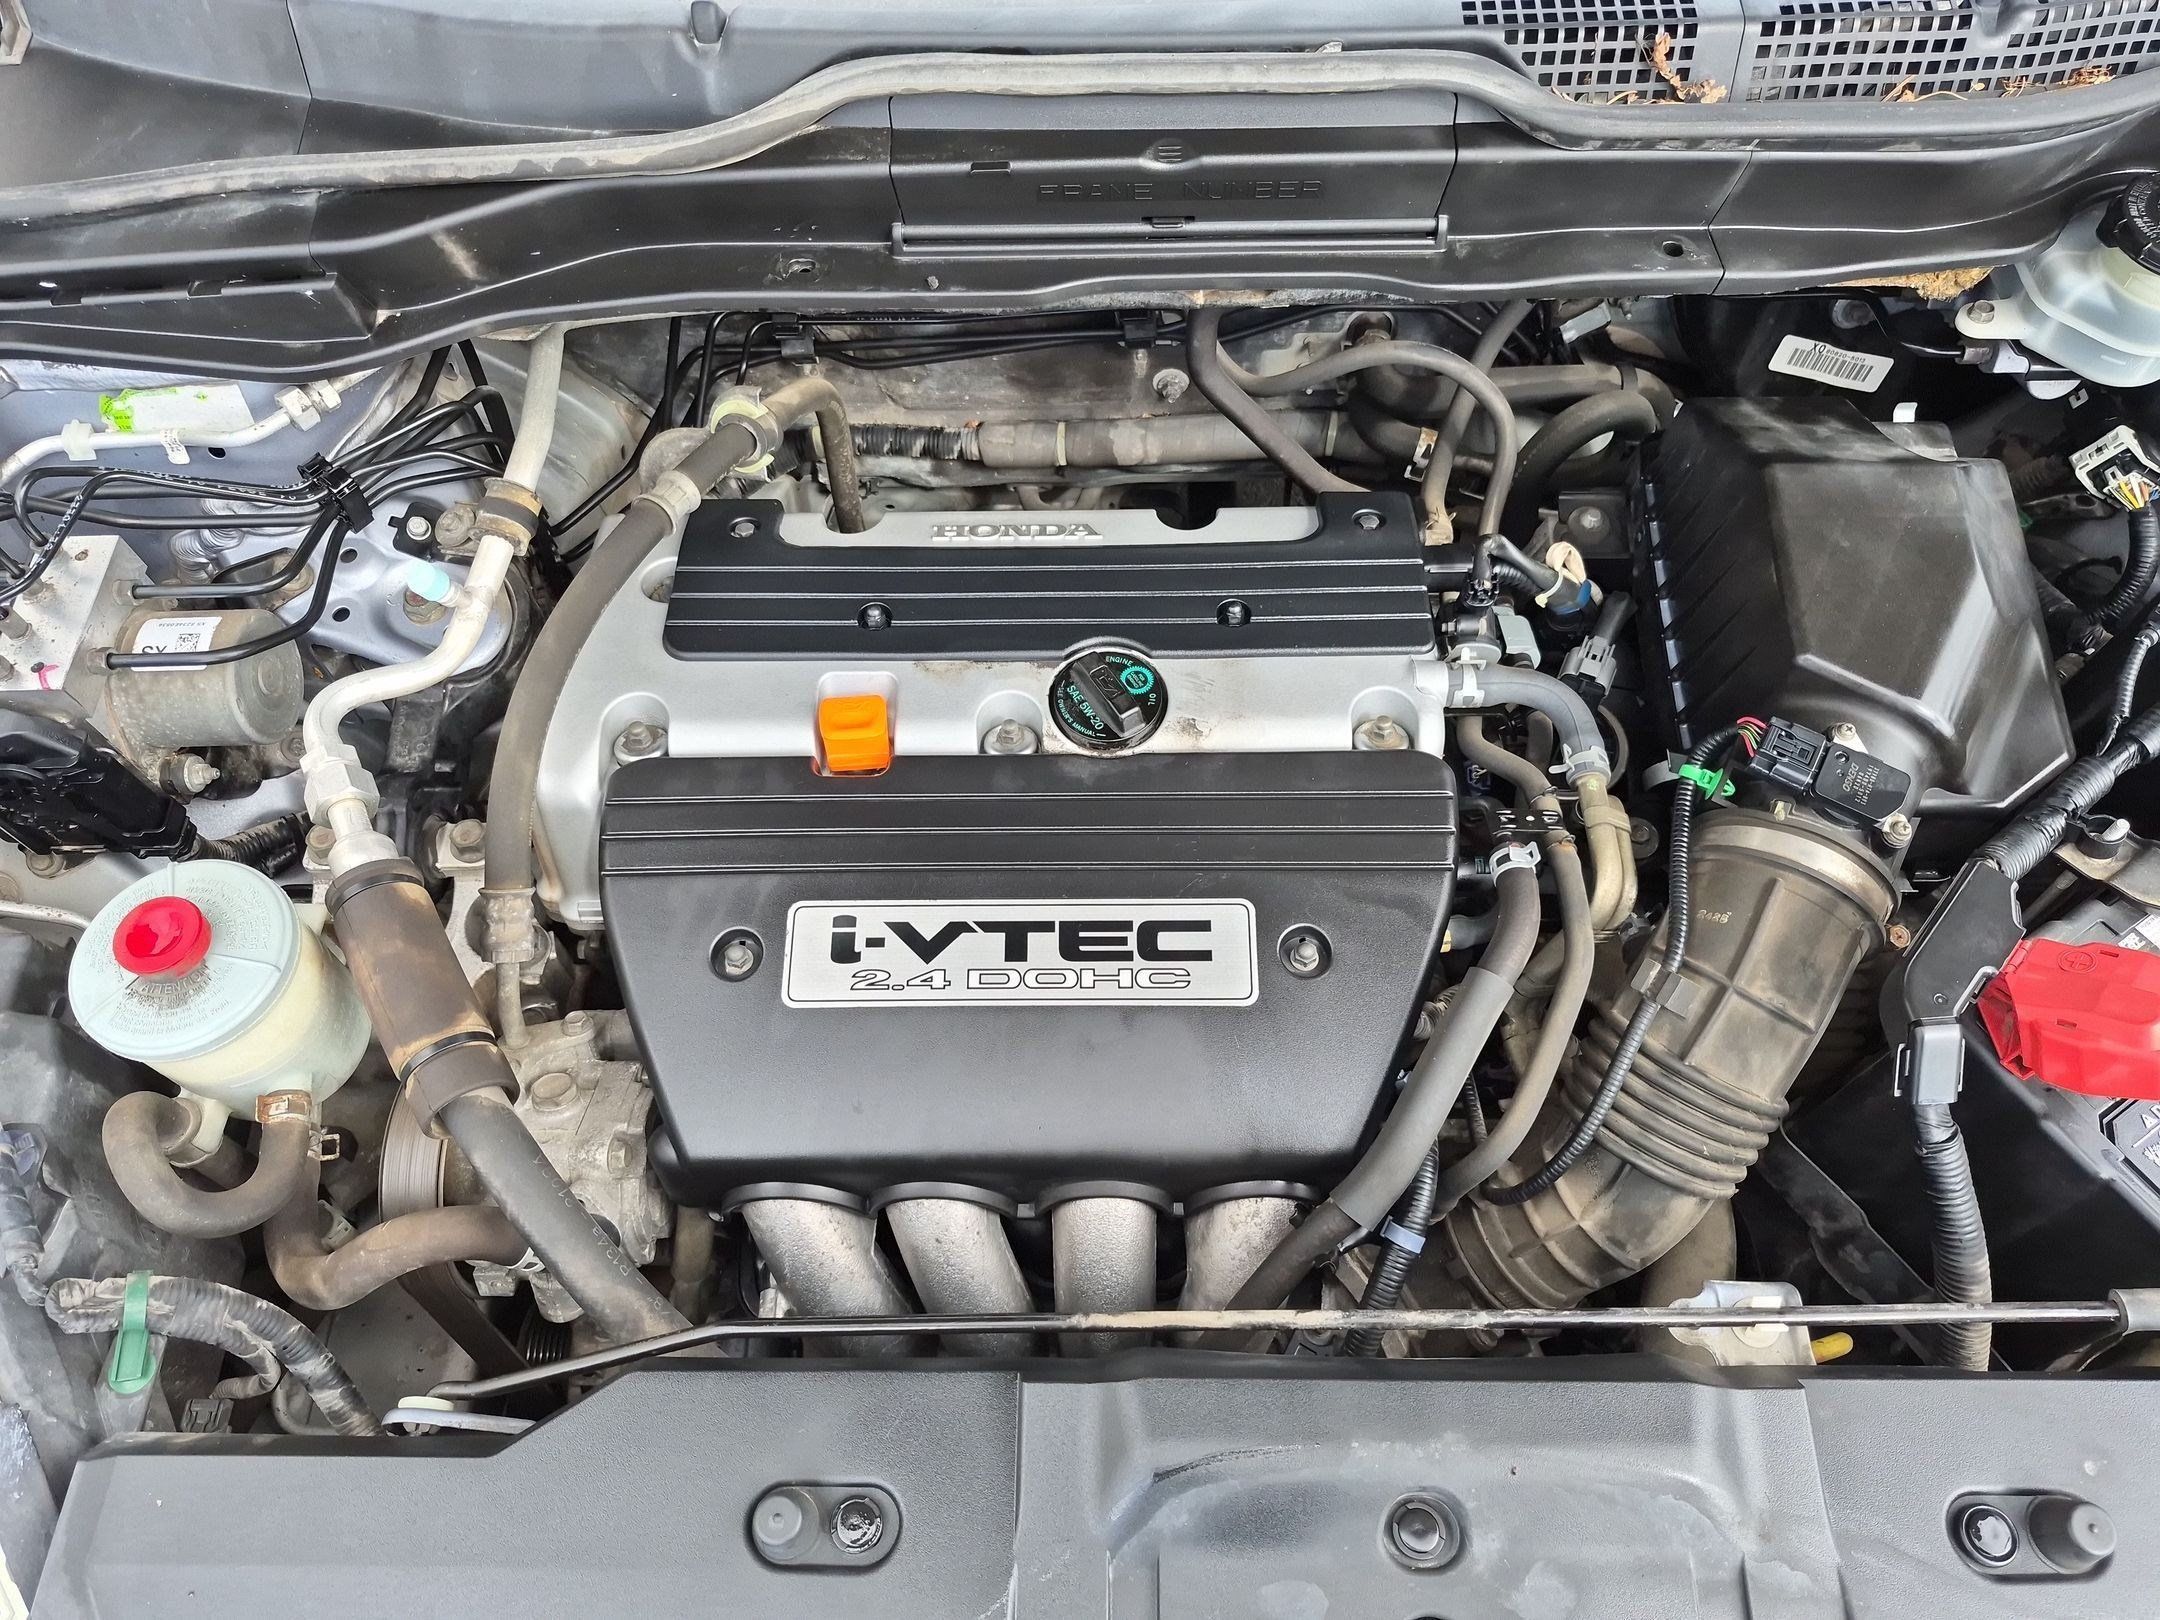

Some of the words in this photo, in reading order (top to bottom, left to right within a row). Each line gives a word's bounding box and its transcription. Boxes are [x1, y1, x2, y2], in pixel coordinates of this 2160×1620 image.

[1039, 184, 1153, 200] FRAME
[1184, 181, 1322, 199] NUMBER
[931, 524, 1103, 541] HONDA
[1105, 655, 1134, 667] ENGINE
[1067, 685, 1084, 703] SAE
[1079, 701, 1104, 730] 5W-20
[1147, 692, 1157, 706] OIL
[1057, 699, 1073, 723] OWNER'S
[1072, 722, 1096, 737] MANUAL
[1842, 762, 1859, 792] DENSO
[830, 914, 1213, 965] i-VTEC
[850, 968, 951, 991] 2.4
[967, 968, 1191, 990] DOHC
